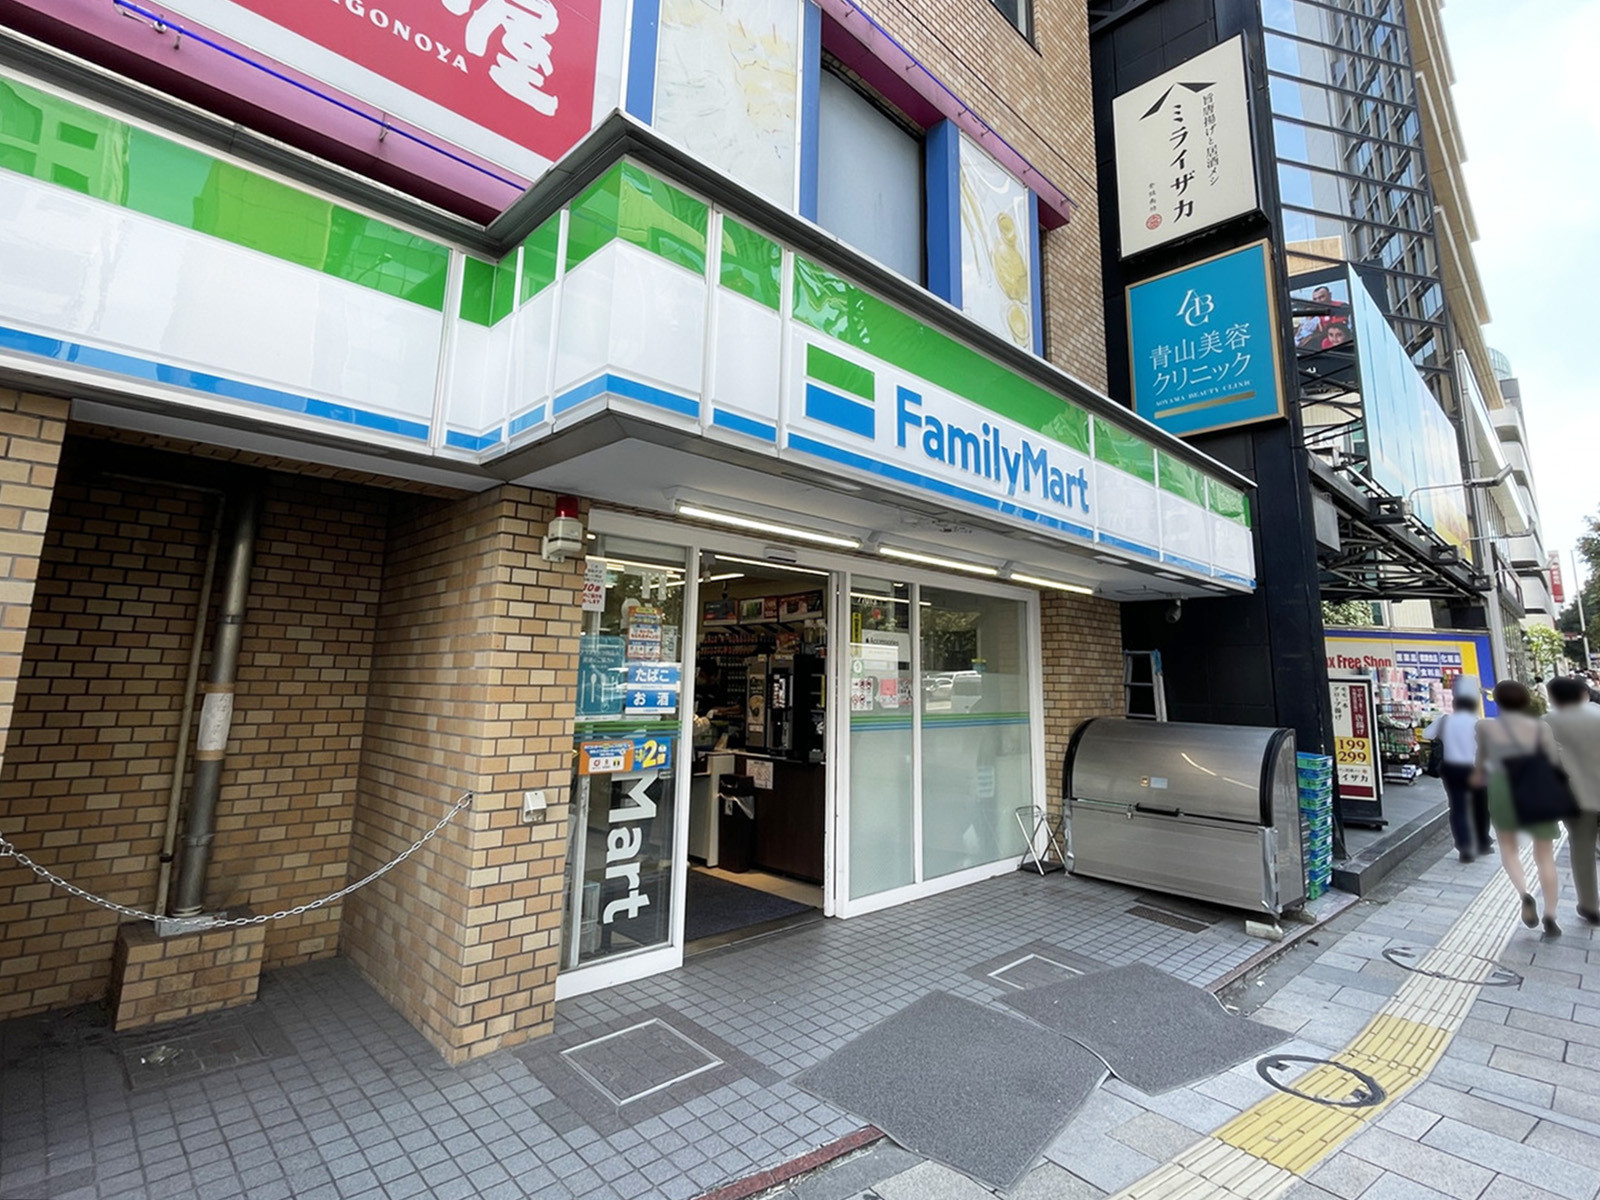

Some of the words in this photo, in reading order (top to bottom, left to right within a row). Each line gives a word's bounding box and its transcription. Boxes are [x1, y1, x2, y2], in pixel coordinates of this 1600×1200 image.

[331, 0, 469, 73] GONOYA
[1169, 104, 1195, 223] ミライザカ
[1149, 323, 1251, 371] 青山美容
[1153, 352, 1251, 396] クリニック
[1156, 396, 1185, 407] AOYAMA
[1188, 387, 1220, 399] BEAUTY
[1222, 380, 1252, 391] CLINIC
[896, 384, 1090, 514] FamilyMart
[635, 668, 669, 682] たばこ
[1337, 654, 1361, 670] Free
[1338, 751, 1367, 763] 299
[1339, 739, 1366, 750] 199
[1341, 773, 1369, 783] イザカ
[603, 771, 657, 925] Mart
